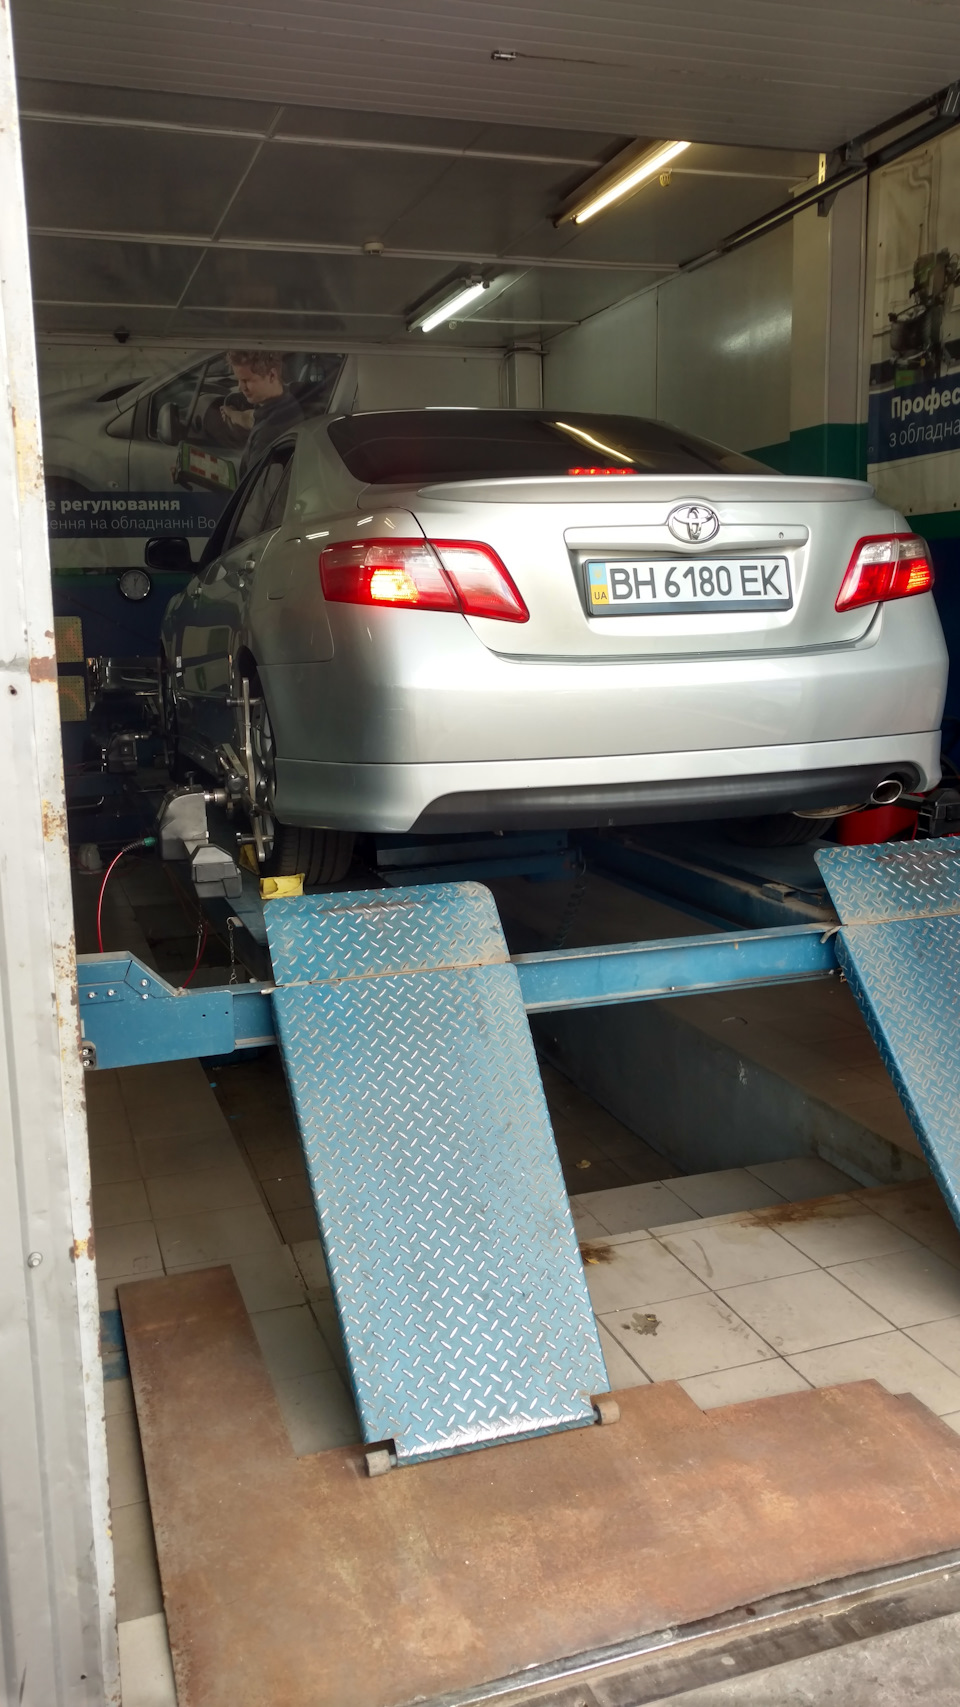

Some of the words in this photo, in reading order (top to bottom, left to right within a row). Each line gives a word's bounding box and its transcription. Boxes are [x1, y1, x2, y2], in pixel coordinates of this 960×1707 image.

[891, 387, 960, 421] Профес
[889, 432, 897, 447] з
[899, 419, 960, 445] обладна
[60, 500, 181, 514] регулювання
[90, 519, 107, 529] на
[111, 516, 194, 531] обладнанні
[609, 567, 657, 600] BH
[664, 565, 732, 598] 6180
[739, 565, 782, 596] EK
[594, 592, 608, 600] UA
